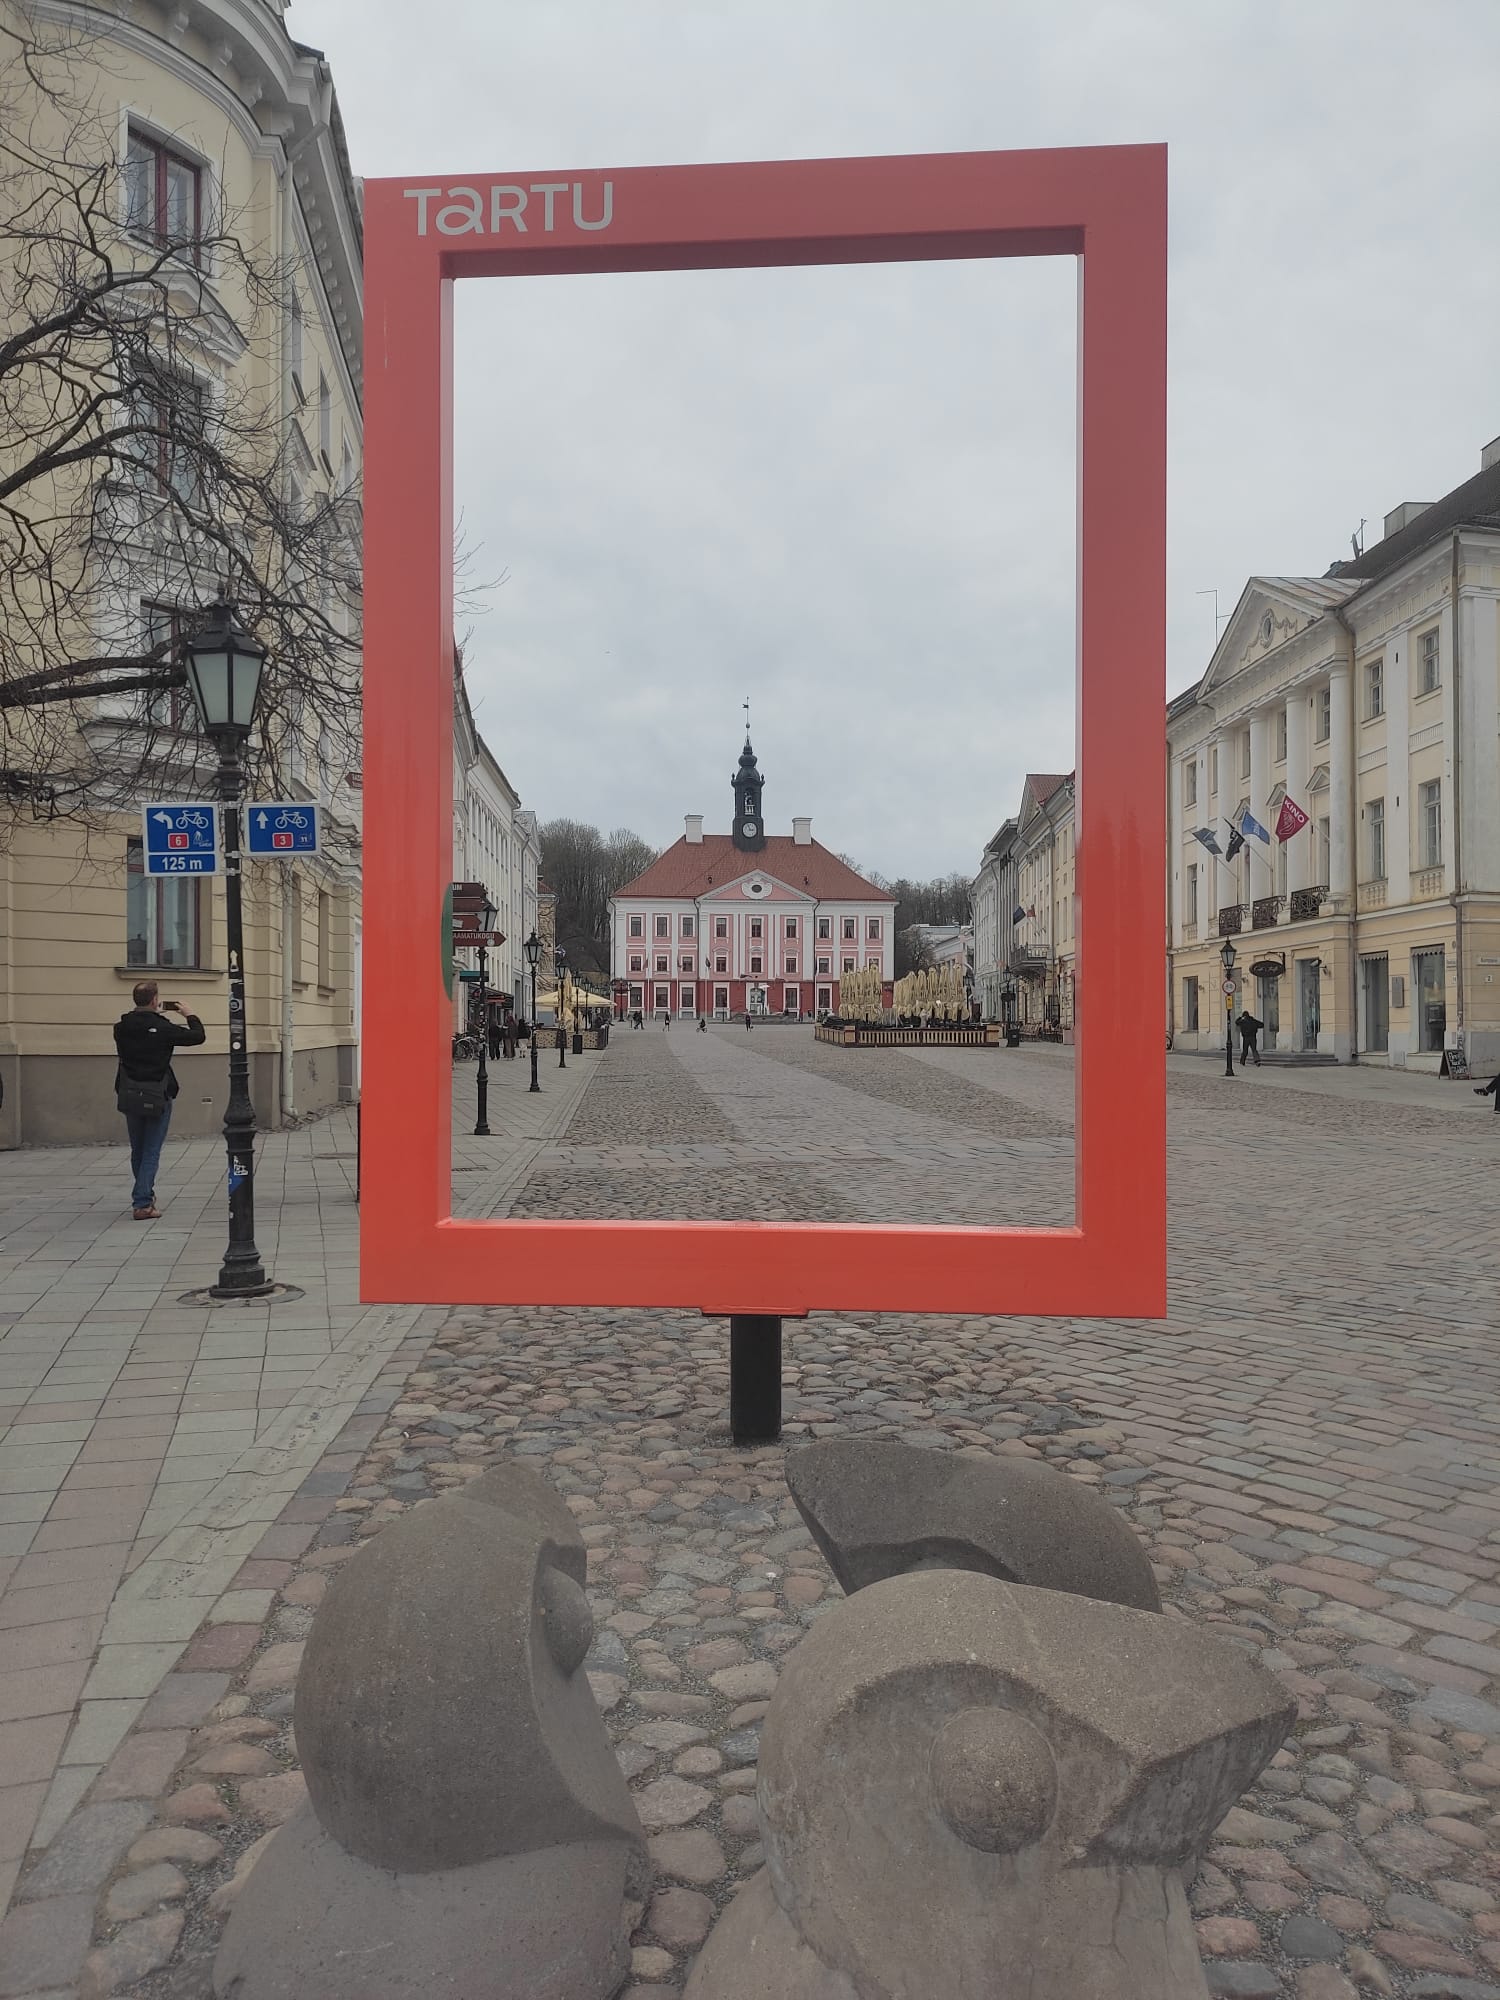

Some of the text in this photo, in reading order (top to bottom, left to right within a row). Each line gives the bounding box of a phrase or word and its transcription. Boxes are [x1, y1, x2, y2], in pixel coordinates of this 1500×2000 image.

[1284, 799, 1305, 823] KINO
[175, 835, 182, 846] 6
[279, 835, 287, 846] 3
[162, 856, 202, 871] 125 m
